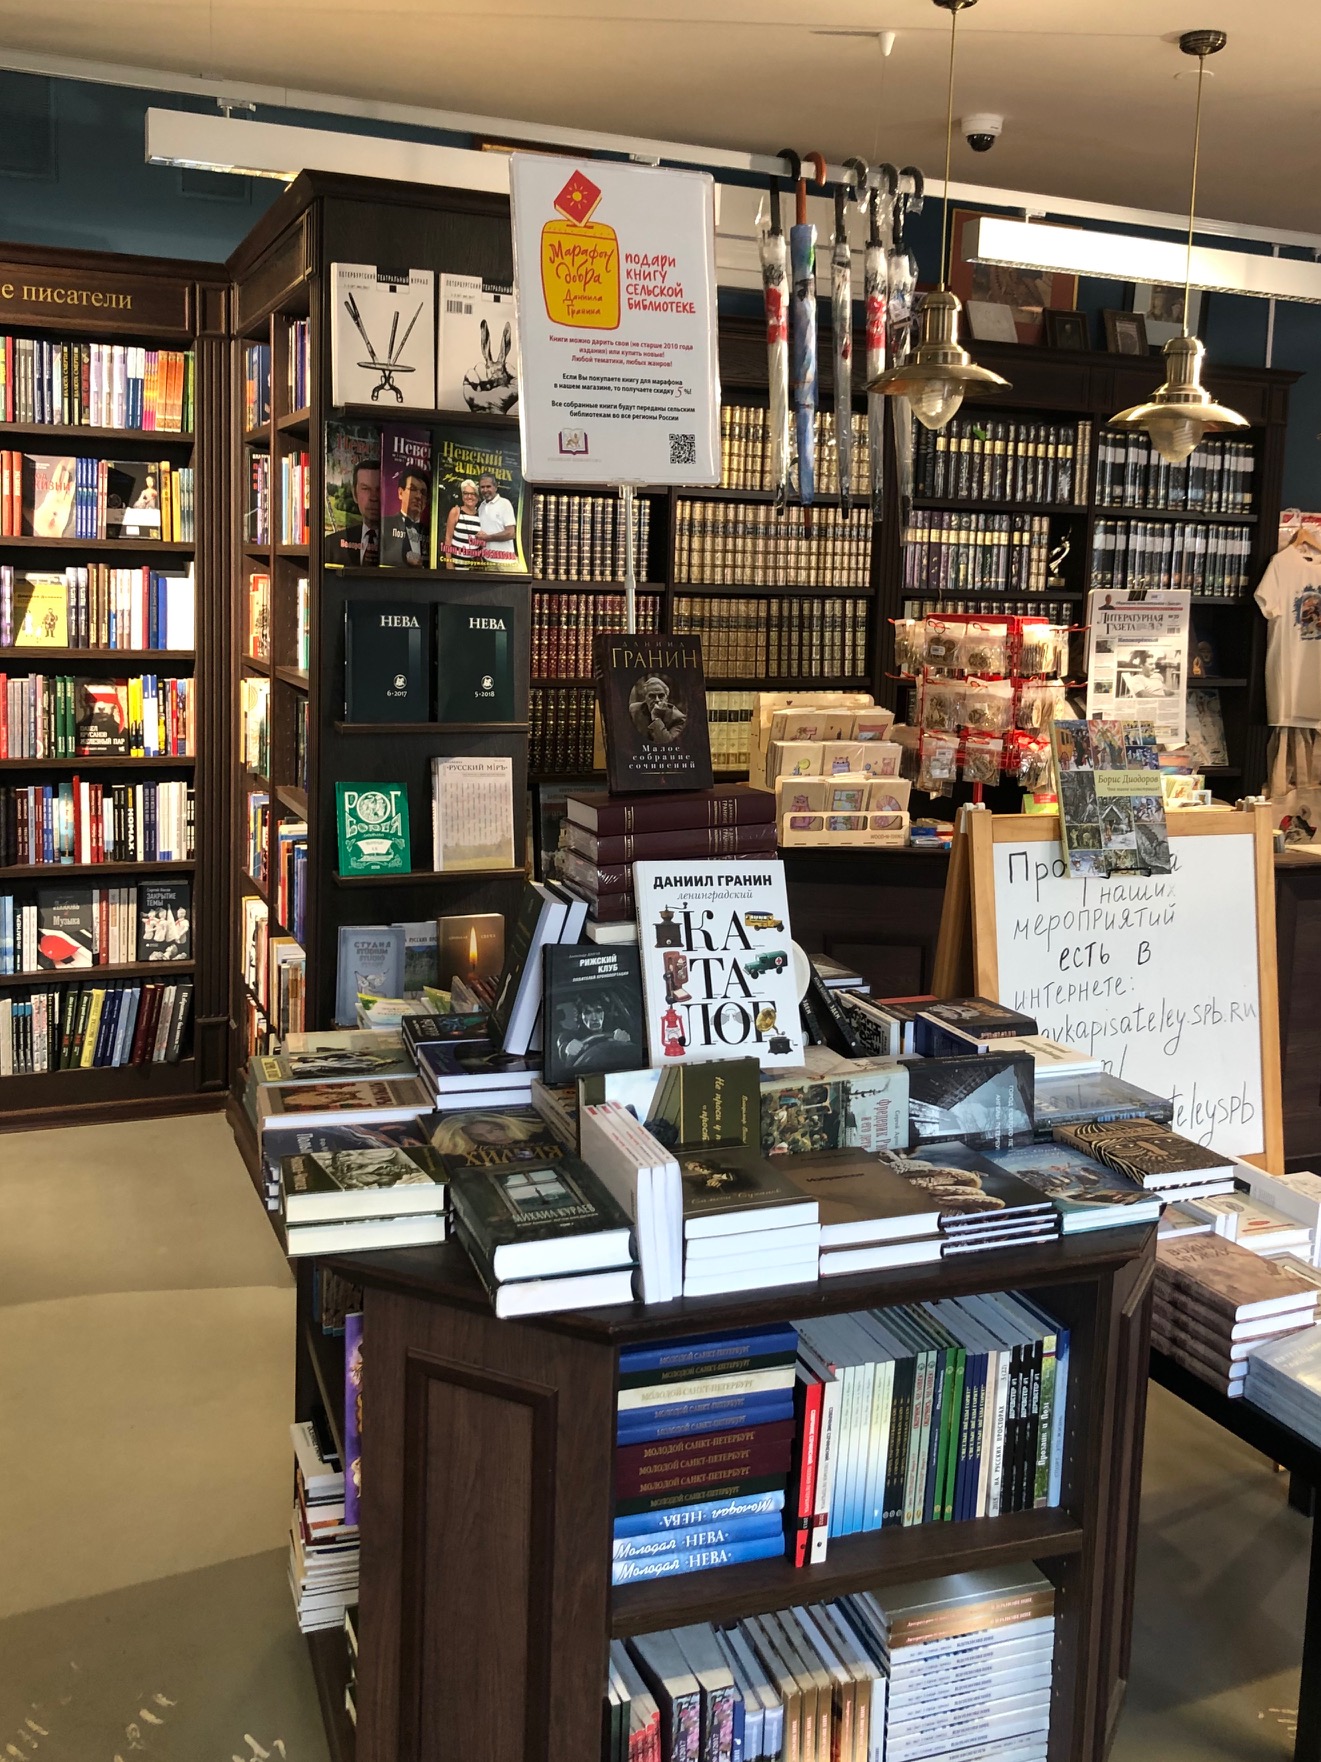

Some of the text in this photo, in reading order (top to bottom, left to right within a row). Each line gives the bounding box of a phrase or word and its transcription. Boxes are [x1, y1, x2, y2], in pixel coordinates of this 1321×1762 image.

[549, 241, 614, 272] Марафон
[626, 269, 668, 284] КНИГУ
[22, 284, 134, 310] писатели
[626, 283, 684, 298] СЕЛЬСКОЙ
[566, 304, 601, 319] Гранина
[627, 299, 696, 314] БИБЛИОТЕКЕ
[549, 335, 569, 344] Книги
[569, 337, 591, 345] можно
[591, 338, 614, 348] дарить
[641, 342, 663, 350] старше
[663, 342, 678, 350] 2010
[679, 344, 694, 352] года
[571, 355, 594, 363] Любой
[594, 357, 625, 366] тематики,
[648, 361, 673, 369] жанров!
[621, 350, 643, 359] купить
[562, 373, 683, 387] Если Вы покупаете книгу для марафона
[581, 384, 613, 393] магазине,
[621, 386, 652, 395] получаете
[653, 387, 674, 396] скидку
[551, 400, 695, 414] Все собранные книги будут переданы сельским
[569, 410, 612, 419] библиотекам
[632, 414, 658, 422] регионы
[442, 440, 503, 467] Невский
[379, 614, 420, 628] НЕВА
[468, 617, 507, 631] НЕВА
[1097, 612, 1164, 625] ЛИТЕРАТУРНАЯ
[1105, 622, 1136, 635] ГАЗЕТА
[612, 648, 697, 669] ГРАНИН
[641, 744, 681, 753] Малое
[632, 752, 691, 762] собрание
[448, 763, 484, 772] РУССКИЙ
[628, 760, 696, 770] сочинений
[1097, 774, 1159, 786] Борис Диодоров
[653, 874, 772, 890] ДАНИИЛ ГРАНИН
[147, 892, 177, 901] ЗАКРЫТИЕ
[147, 899, 164, 907] ТЕМЫ
[676, 890, 753, 903] ленинградский
[1013, 902, 1177, 952] мероприятий
[353, 940, 392, 949] СТУДИЯ
[579, 954, 618, 967] РИЖСКИЙ
[1059, 941, 1111, 972] есть
[597, 963, 619, 974] КЛУБ
[1013, 976, 1136, 1011] интернете:
[714, 1076, 725, 1091] Не
[712, 1093, 723, 1121] проси
[873, 1098, 892, 1138] Фредерик
[511, 1209, 558, 1224] МИХАИЛ
[559, 1203, 596, 1219] КУРАЕВ
[996, 1405, 1005, 1441] ПРОСТОРАХ
[643, 1431, 756, 1458] МОЛОДОЙ САНКТ-ПЕТЕРБУРГ
[1036, 1431, 1048, 1466] Прозаик
[638, 1449, 751, 1476] МОЛОДОЙ САНКТ-ПЕТЕРБУРГ
[994, 1446, 1002, 1473] РУССКИХ
[639, 1466, 752, 1493] МОЛОДОЙ САНКТ-ПЕТЕРБУРГ
[993, 1476, 1000, 1486] НА
[614, 1539, 677, 1561] Молодая
[618, 1559, 680, 1581] Молодая
